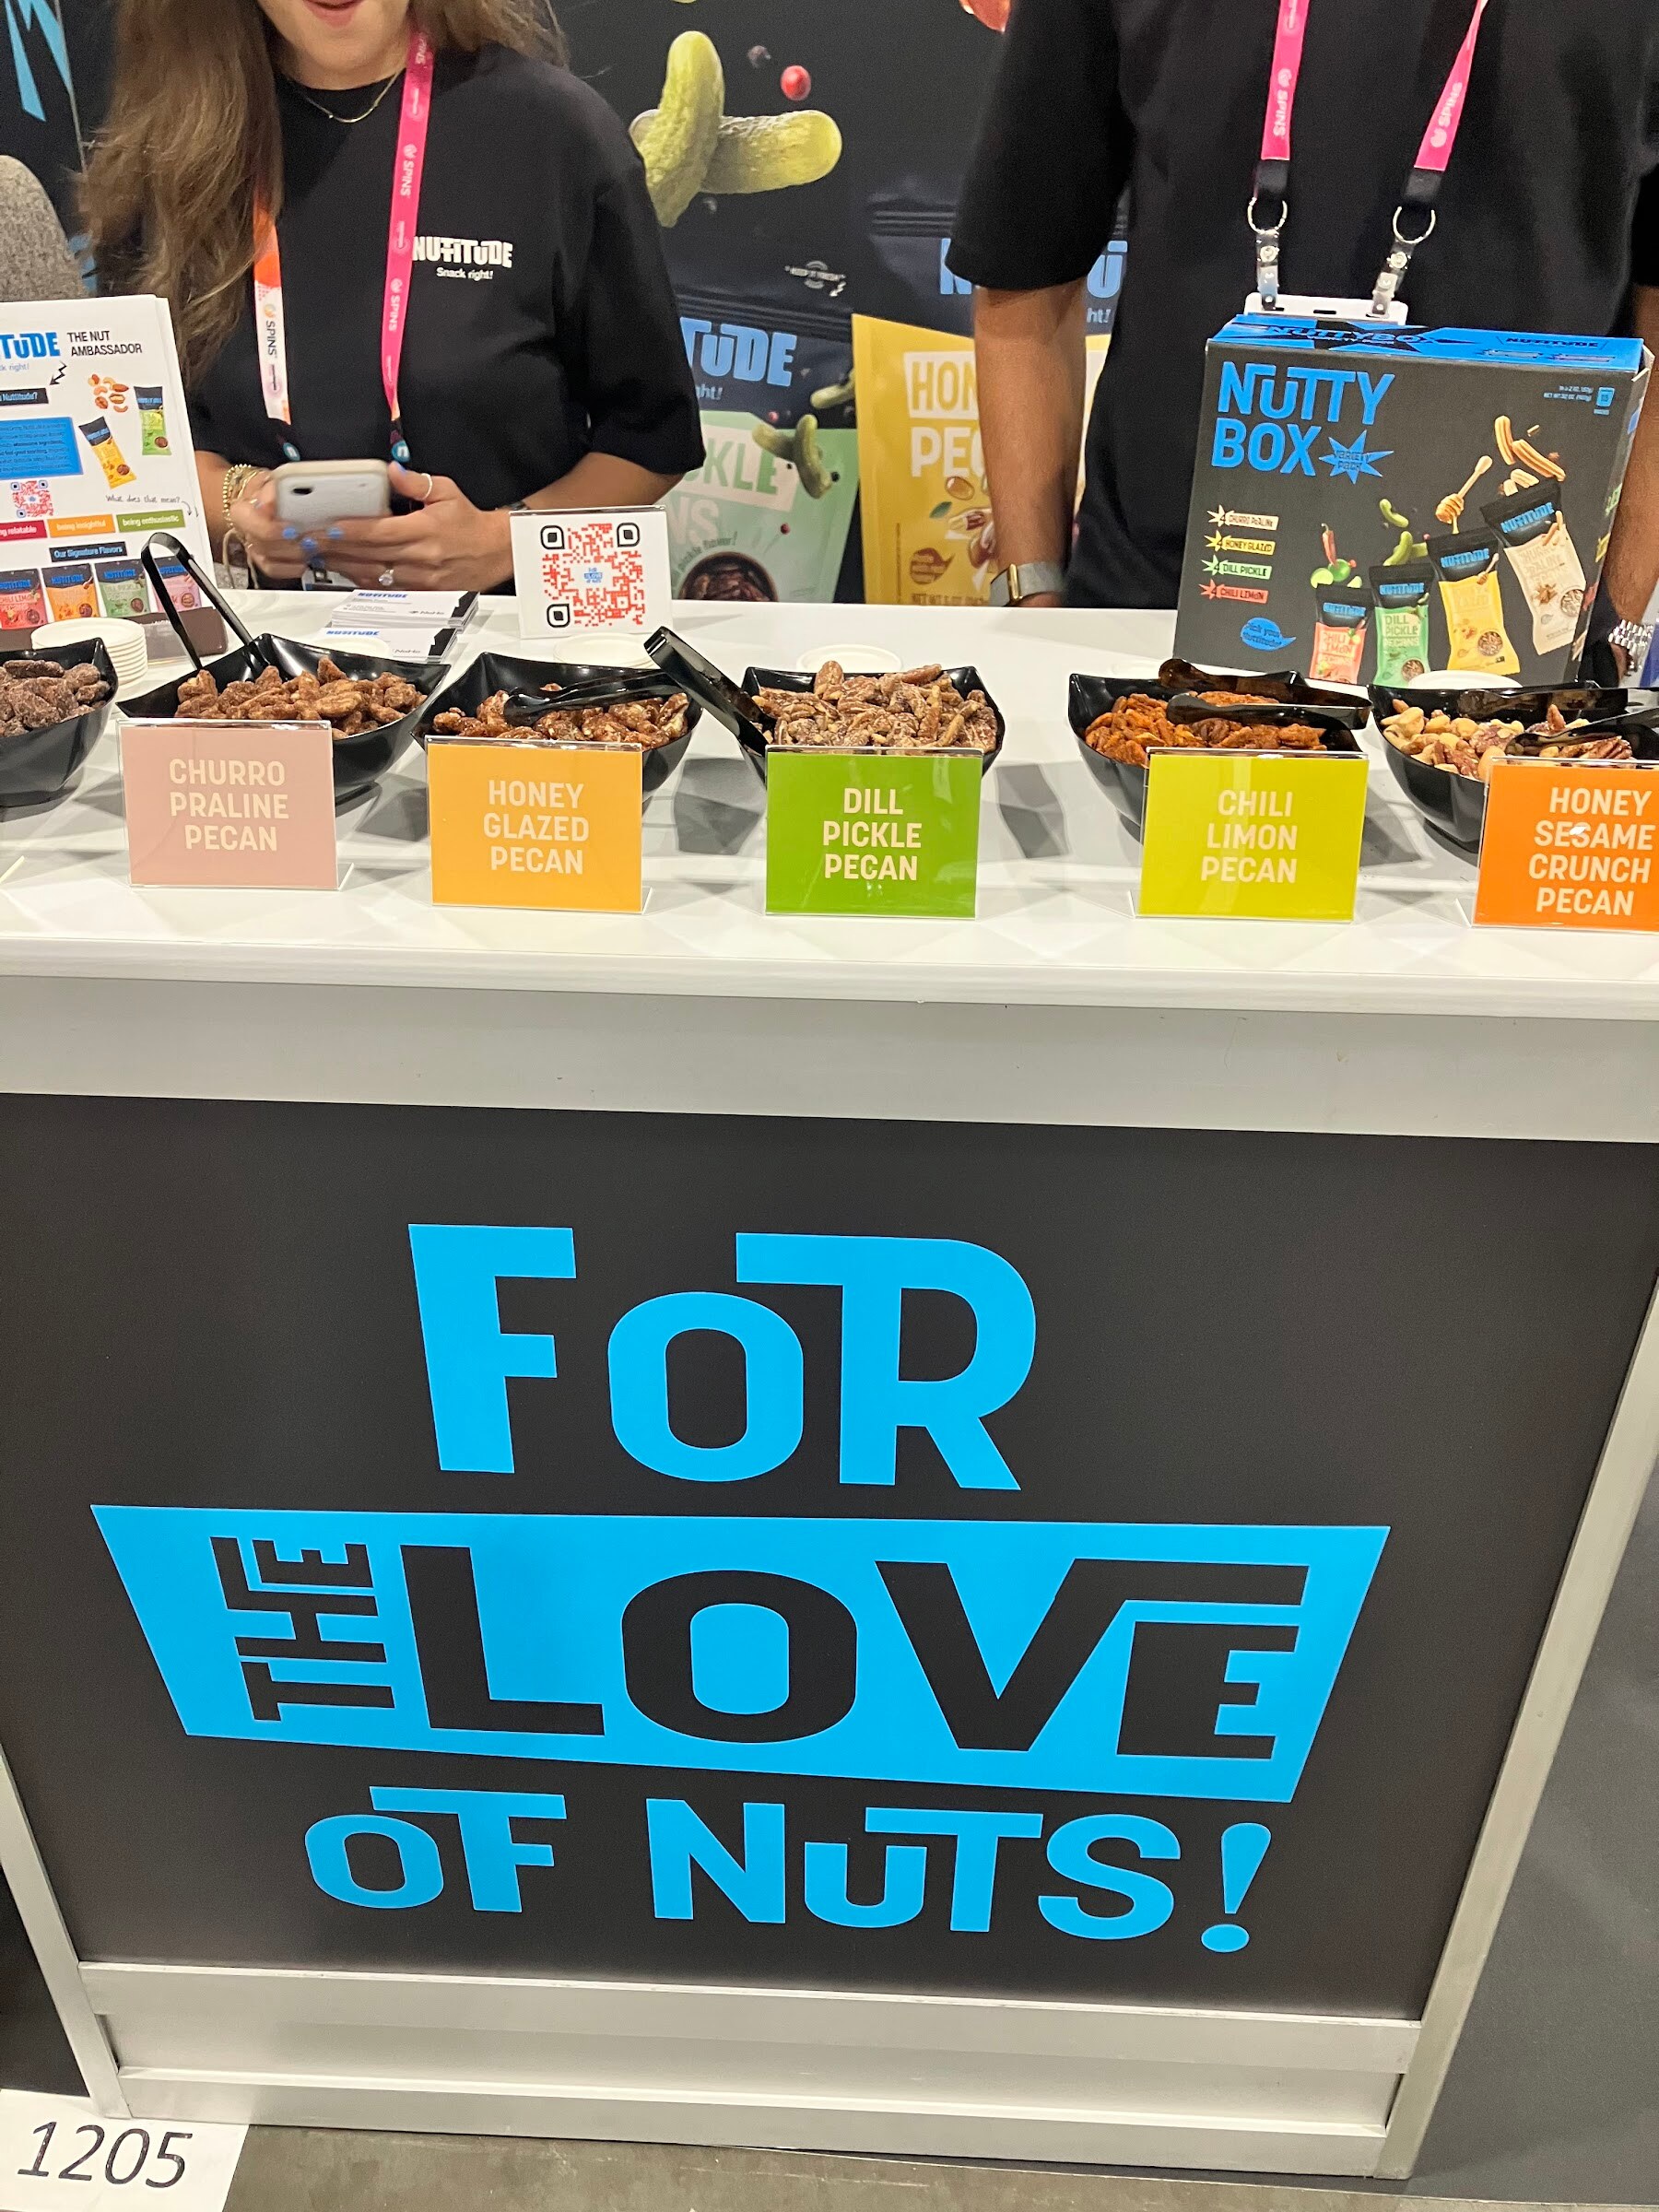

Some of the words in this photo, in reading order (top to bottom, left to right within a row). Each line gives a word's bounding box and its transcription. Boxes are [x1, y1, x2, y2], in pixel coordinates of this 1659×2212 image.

[1273, 89, 1288, 136] SPINS
[1439, 81, 1463, 127] SPINS
[400, 159, 415, 196] SPINS
[436, 267, 466, 278] Snack
[388, 293, 401, 332] SPINS
[67, 331, 88, 343] THE
[90, 330, 111, 342] NUT
[71, 343, 143, 357] AMBASSADOR
[265, 319, 277, 357] SPINS
[1218, 360, 1395, 425] NUTTY
[1211, 417, 1322, 477] BOX
[684, 438, 779, 495] KLE
[7, 525, 37, 535] relatable
[123, 518, 141, 526] being
[141, 515, 179, 524] enthusiastic
[66, 547, 99, 559] Signature
[99, 546, 123, 555] Flavors
[1226, 540, 1247, 549] HONEY
[1248, 542, 1273, 552] GLAZED
[1222, 563, 1238, 573] DILL
[1240, 566, 1267, 577] PICKLE
[1220, 588, 1239, 597] CHILI
[1241, 590, 1264, 600] LIMON
[1384, 615, 1409, 625] DILL
[1385, 624, 1418, 636] PICKLE
[169, 758, 285, 787] CHURRO
[170, 792, 288, 819] PRALINE
[488, 780, 585, 808] HONEY
[843, 787, 904, 816] DILL
[1217, 789, 1293, 818] CHILI
[1549, 787, 1653, 817] HONEY
[184, 824, 277, 852] PECAN
[483, 812, 590, 841] GLAZED
[823, 820, 922, 849] PICKLE
[1206, 823, 1298, 851] LIMON
[1534, 819, 1656, 851] SESAME
[489, 846, 583, 875] PECAN
[824, 853, 918, 880] PECAN
[1200, 855, 1298, 884] PECAN
[1528, 853, 1652, 884] CRUNCH
[1535, 887, 1634, 916] PECAN
[210, 1536, 395, 1722] THE
[400, 1543, 1312, 1761] LOVE
[303, 1786, 568, 1915] OF
[18, 2121, 193, 2188] 1205
